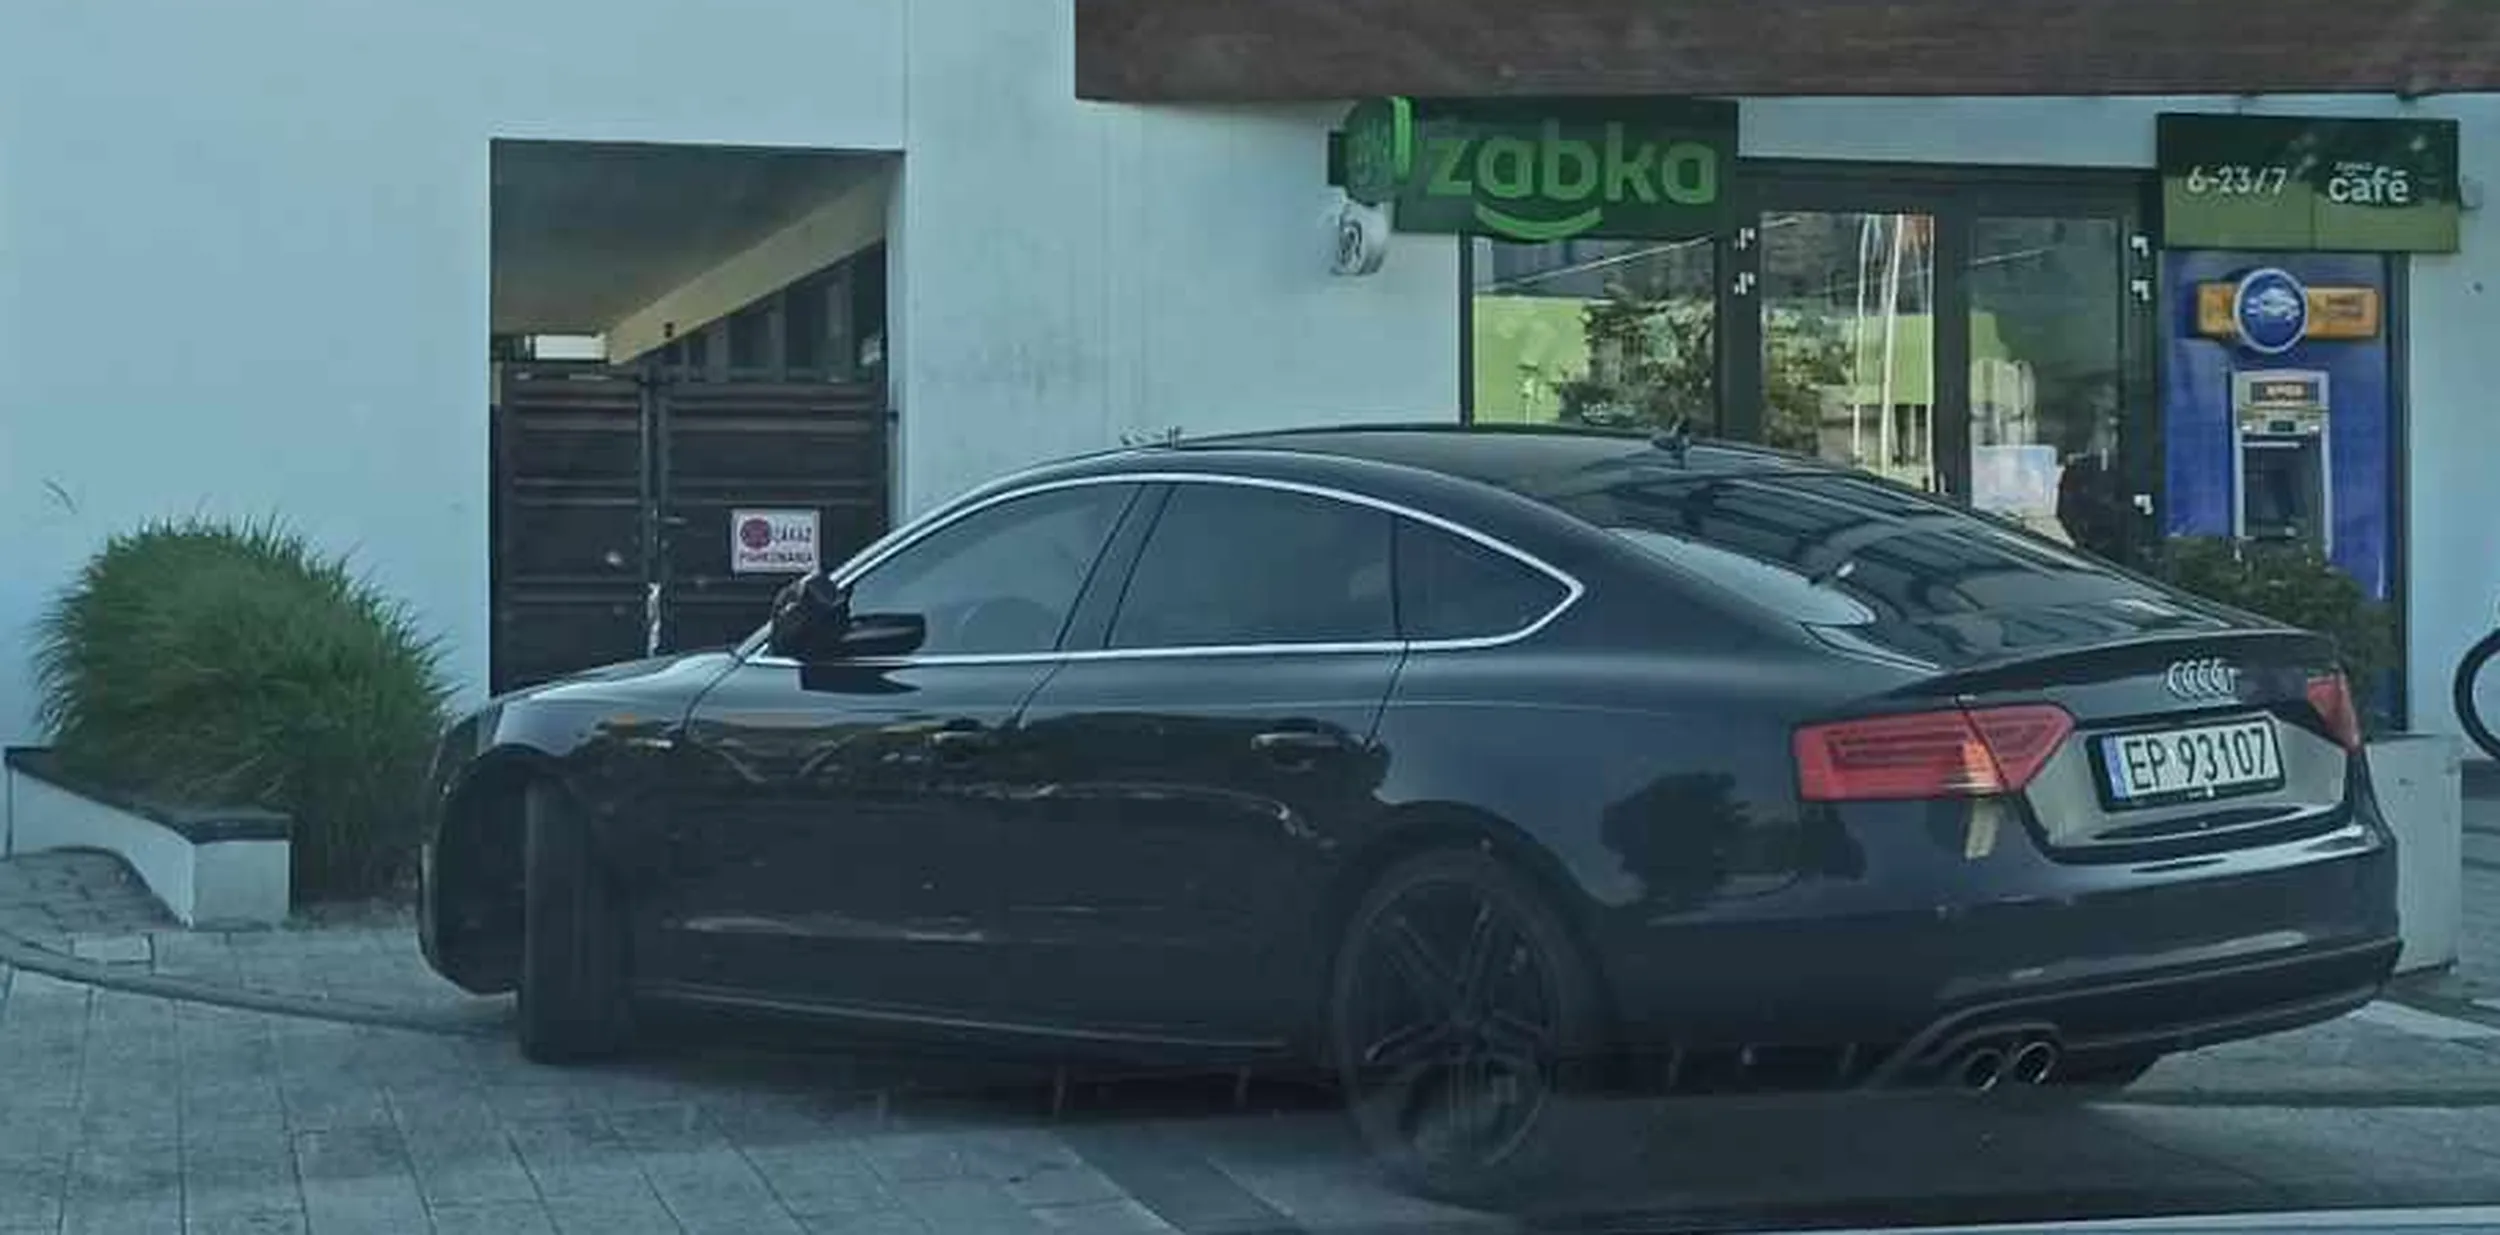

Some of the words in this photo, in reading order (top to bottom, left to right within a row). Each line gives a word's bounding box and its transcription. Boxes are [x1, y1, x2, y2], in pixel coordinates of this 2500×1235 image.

[2187, 165, 2287, 195] 6-23/7
[2328, 166, 2410, 203] café
[2124, 737, 2166, 789] EP
[2179, 726, 2267, 784] 93107
